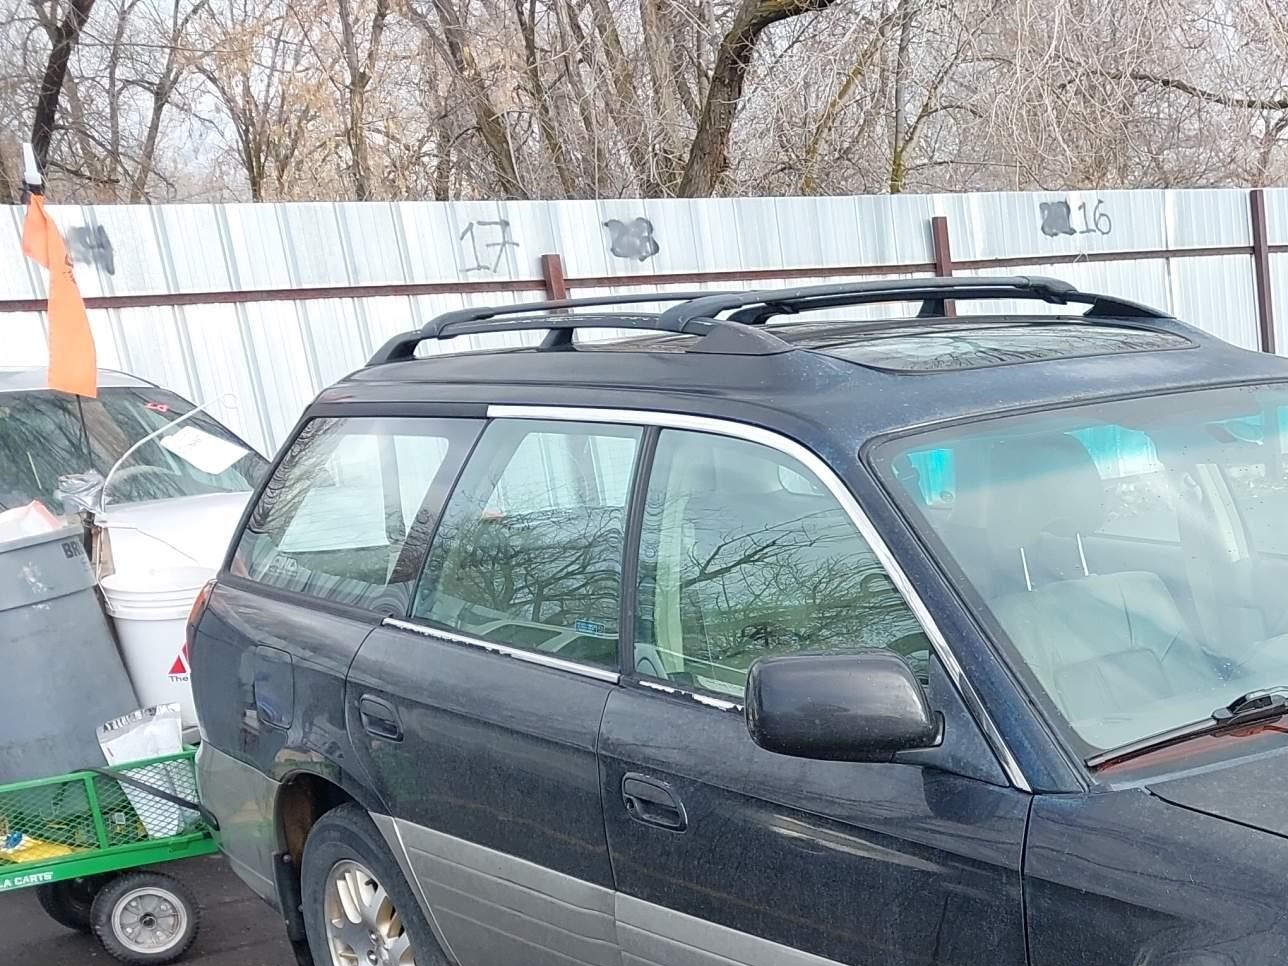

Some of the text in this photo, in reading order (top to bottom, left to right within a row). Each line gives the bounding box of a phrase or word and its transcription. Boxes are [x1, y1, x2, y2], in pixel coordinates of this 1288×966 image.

[1078, 198, 1112, 235] 16
[460, 219, 520, 274] 17
[14, 871, 54, 886] CARTS
